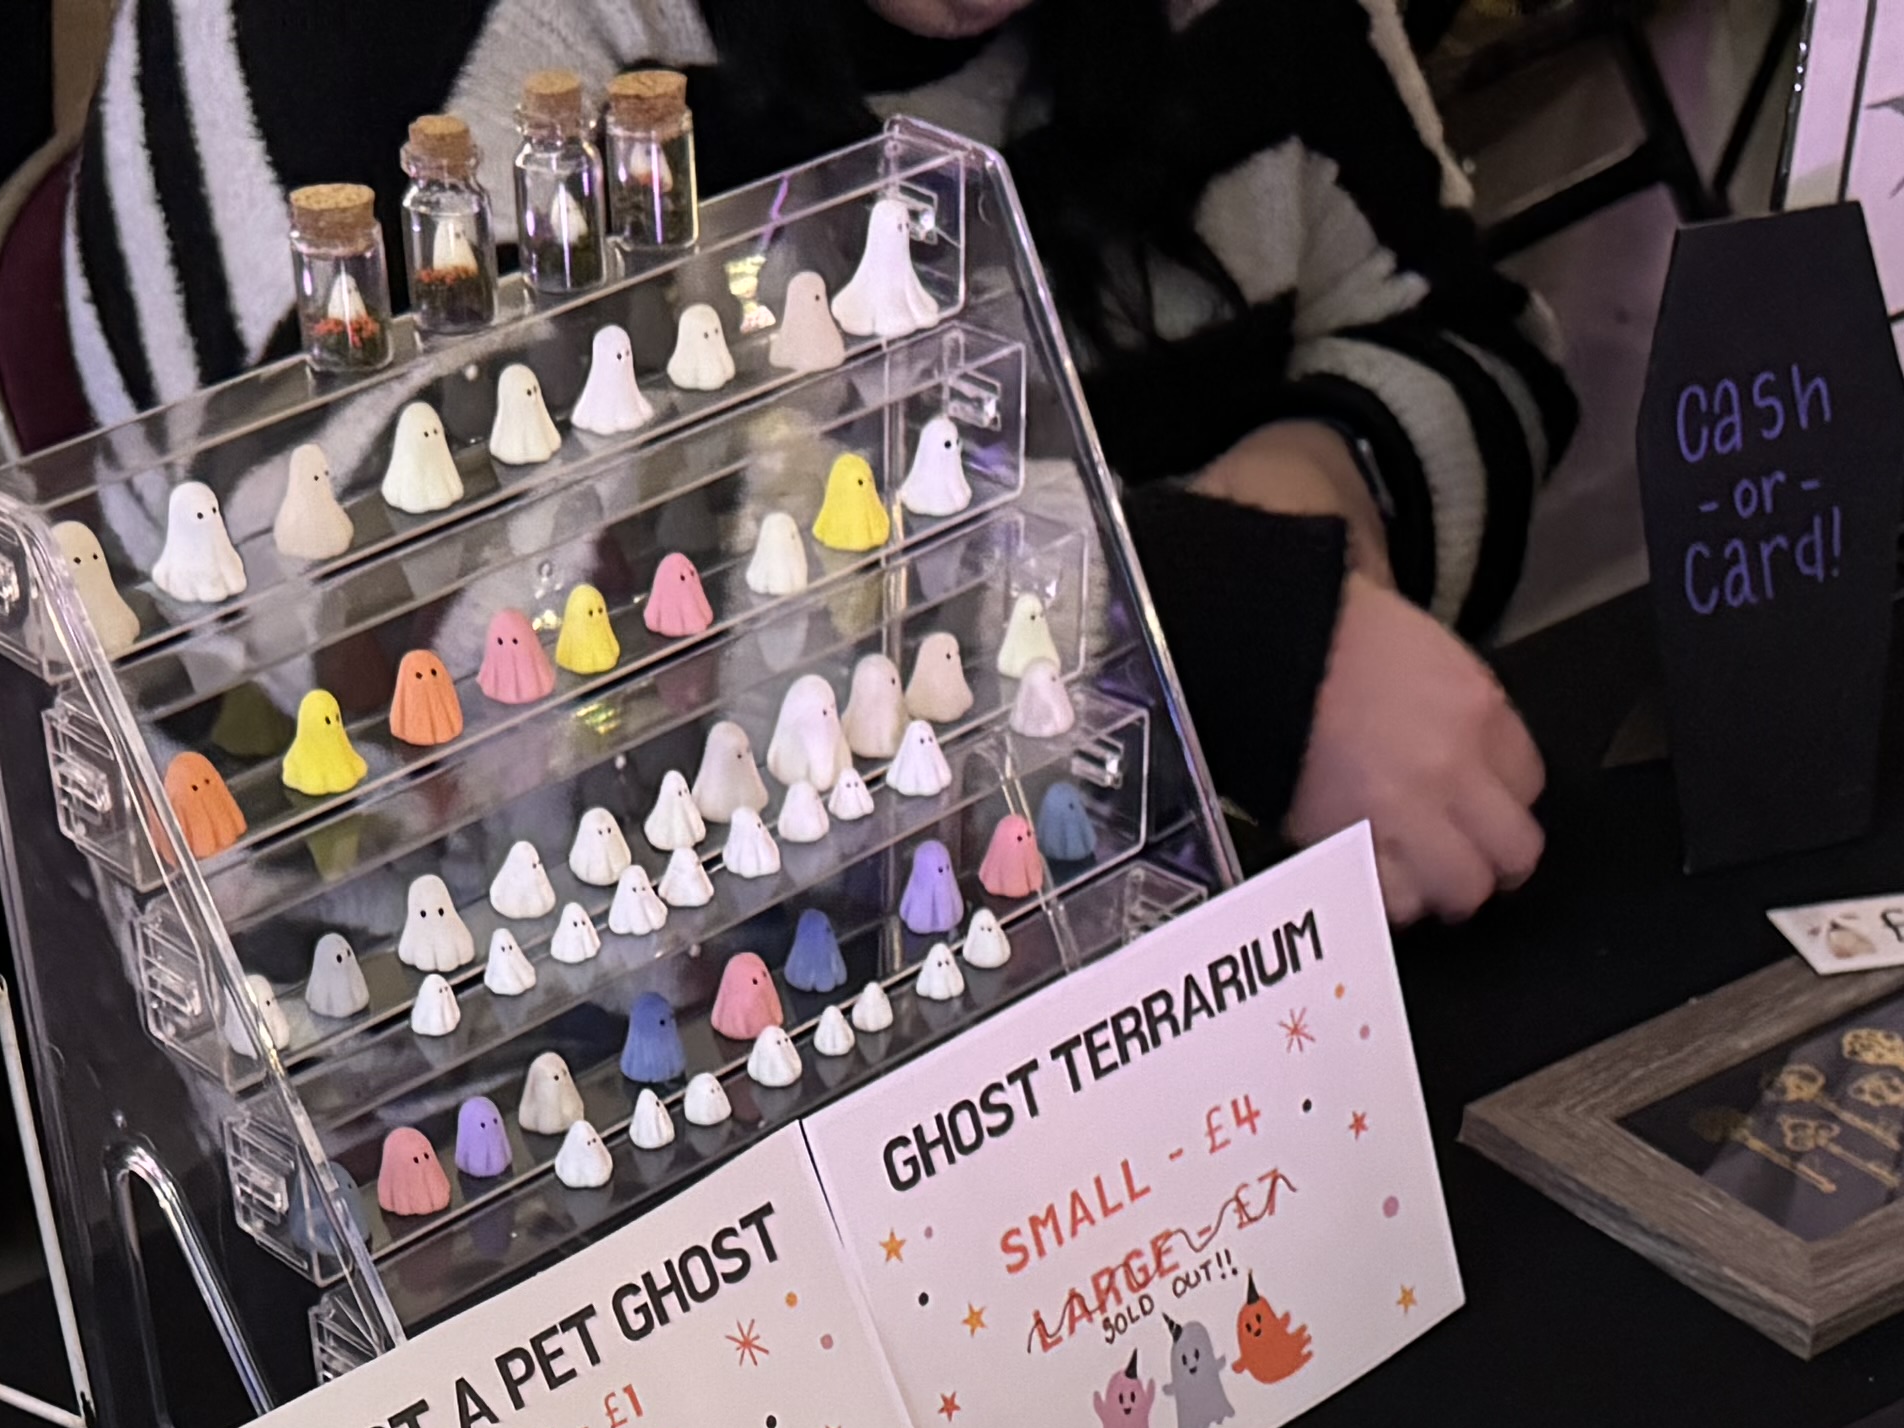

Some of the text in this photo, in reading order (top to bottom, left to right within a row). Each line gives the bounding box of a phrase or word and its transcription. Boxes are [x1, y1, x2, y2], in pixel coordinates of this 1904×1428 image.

[882, 909, 1324, 1192] GHOST TERRARIUM
[1000, 1160, 1152, 1275] SMALL
[1204, 1095, 1263, 1154] £4
[495, 1306, 601, 1410] PET
[612, 1204, 781, 1340] GHOST
[1032, 1230, 1181, 1352] LARGE
[1102, 1250, 1240, 1345] SOLD OUT!!
[605, 1384, 645, 1428] £1
